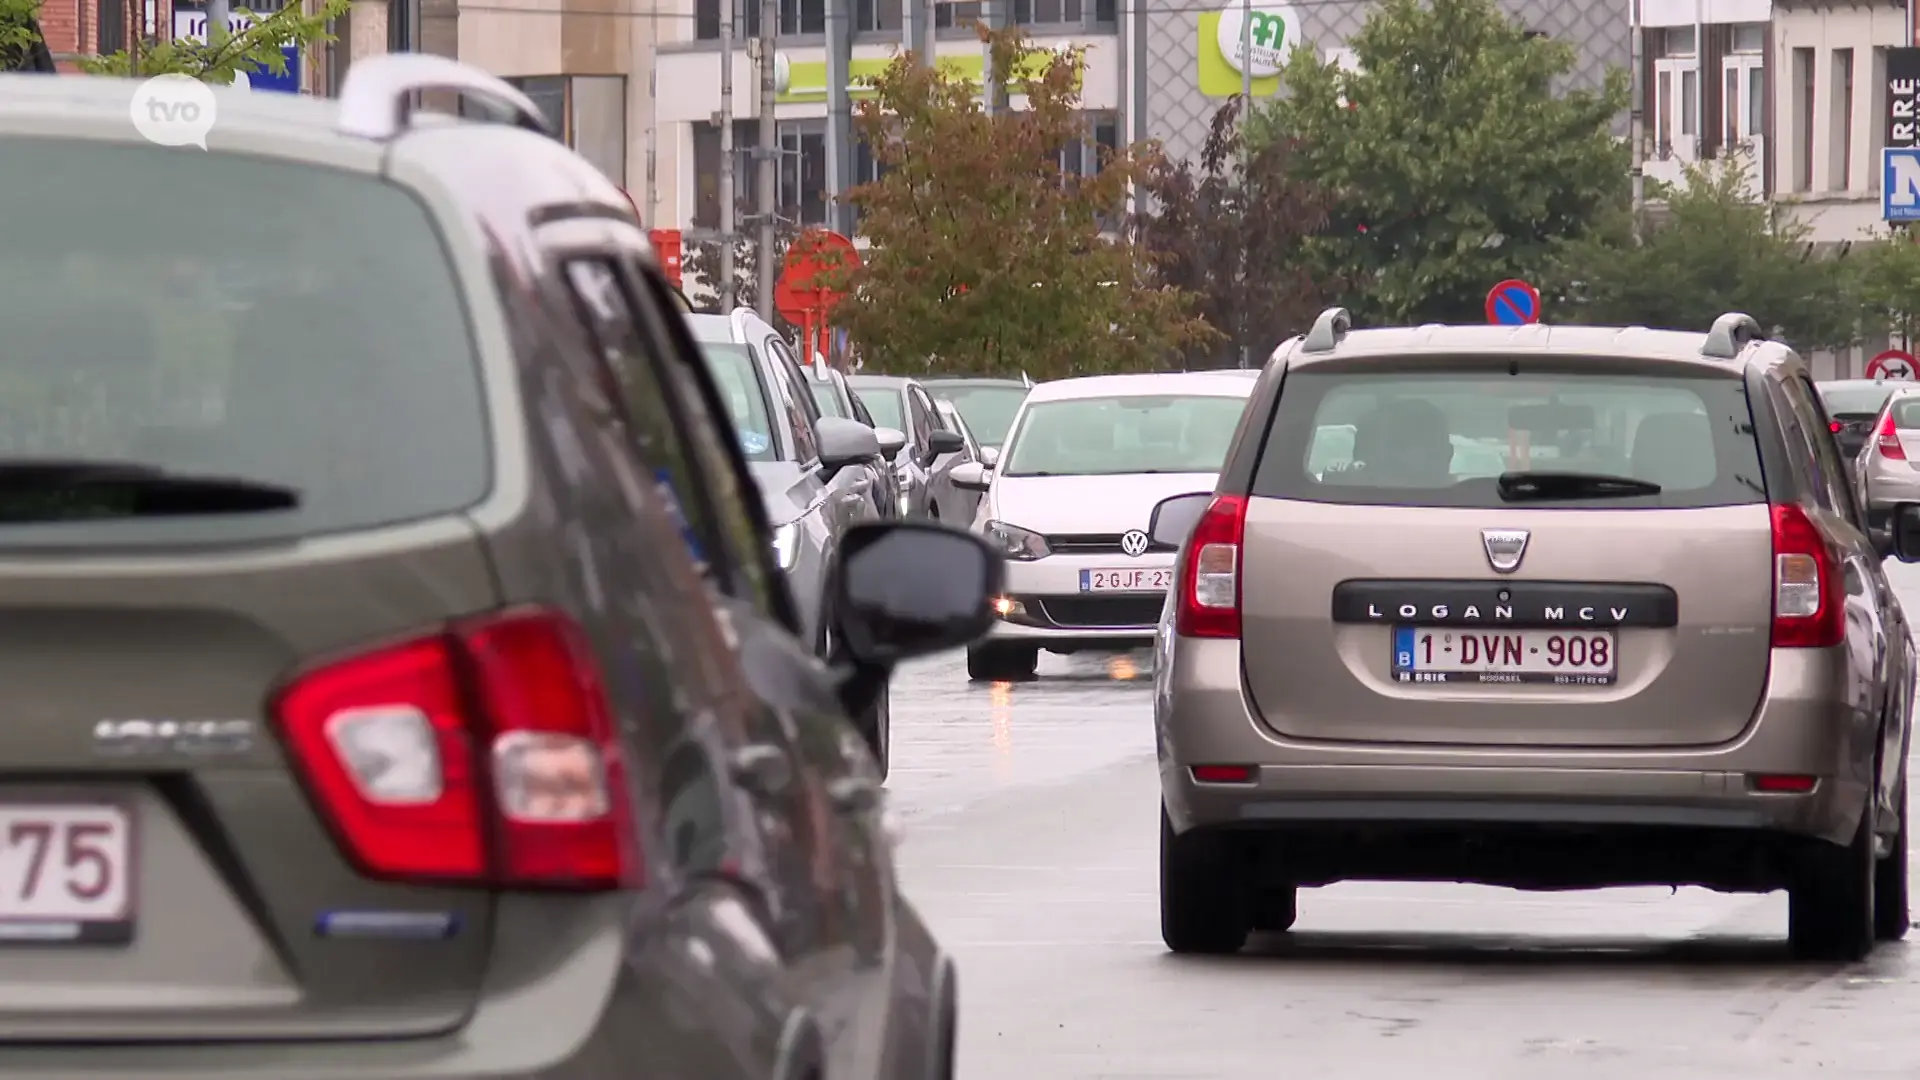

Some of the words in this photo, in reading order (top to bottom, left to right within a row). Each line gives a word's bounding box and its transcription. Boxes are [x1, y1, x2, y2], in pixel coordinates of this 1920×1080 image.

[1889, 79, 1914, 148] RRÉ
[1368, 604, 1513, 619] LOGAN
[1544, 606, 1628, 621] MCV
[1399, 651, 1411, 667] B
[9, 821, 114, 902] 75
